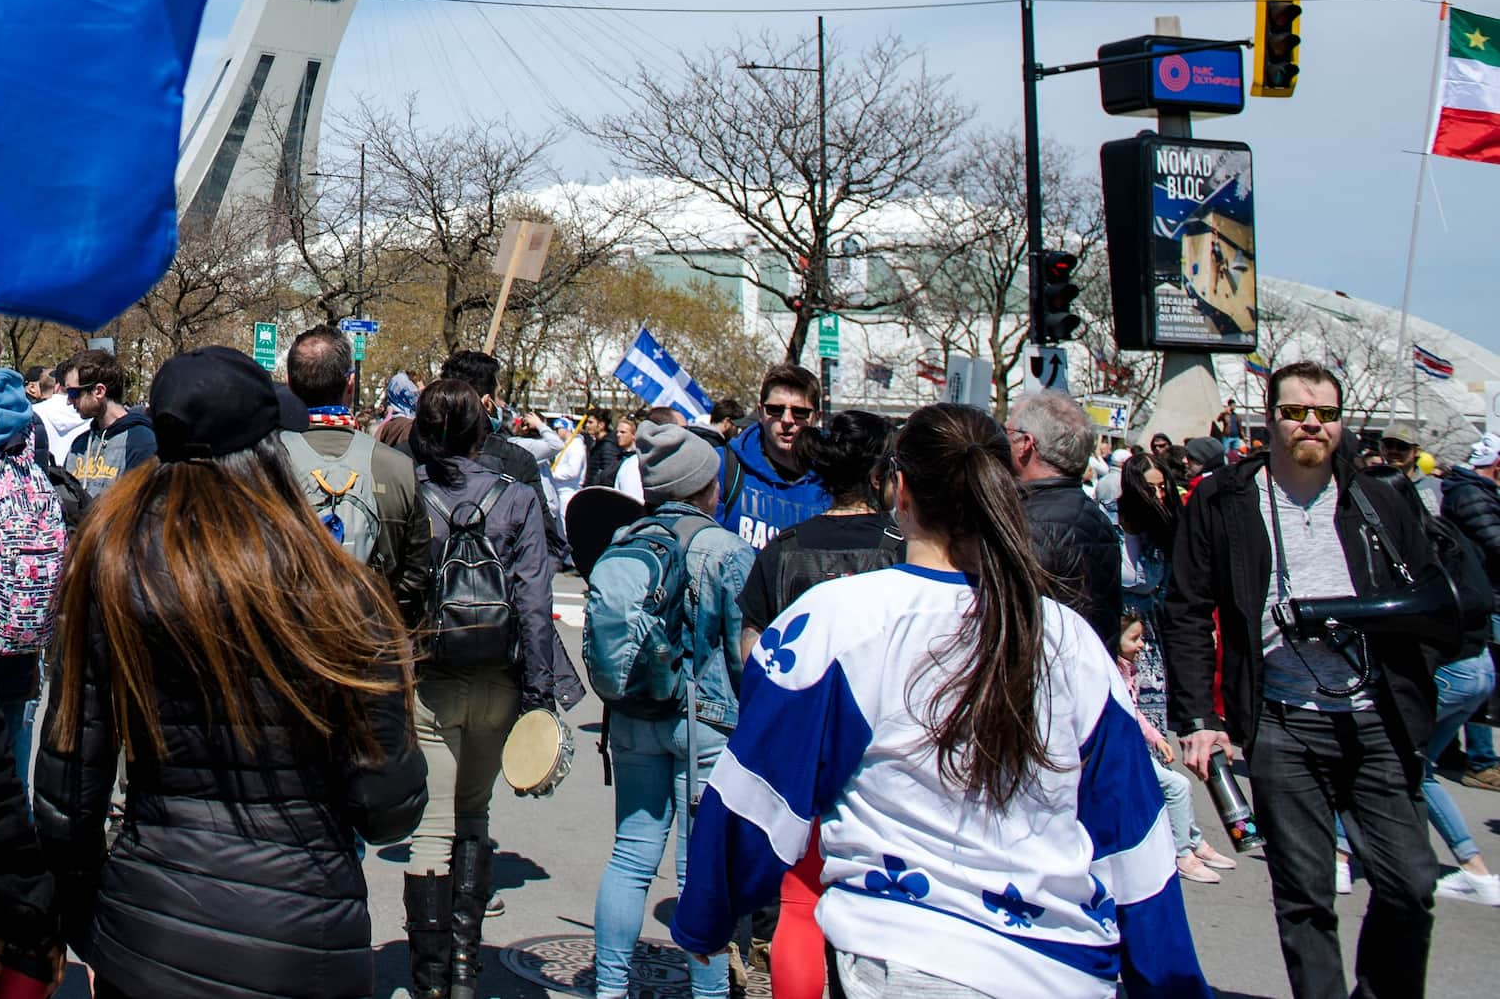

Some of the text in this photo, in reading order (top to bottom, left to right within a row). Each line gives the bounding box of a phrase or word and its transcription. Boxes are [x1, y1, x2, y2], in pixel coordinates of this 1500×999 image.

[1192, 65, 1214, 76] PARC
[1192, 75, 1241, 87] OLYMPIQUE
[1156, 149, 1212, 177] NOMAD
[1166, 175, 1205, 200] BLOC
[1158, 296, 1199, 307] ESCALADE
[1158, 305, 1192, 315] AU PARC
[1158, 314, 1205, 324] OLYMPIQUE
